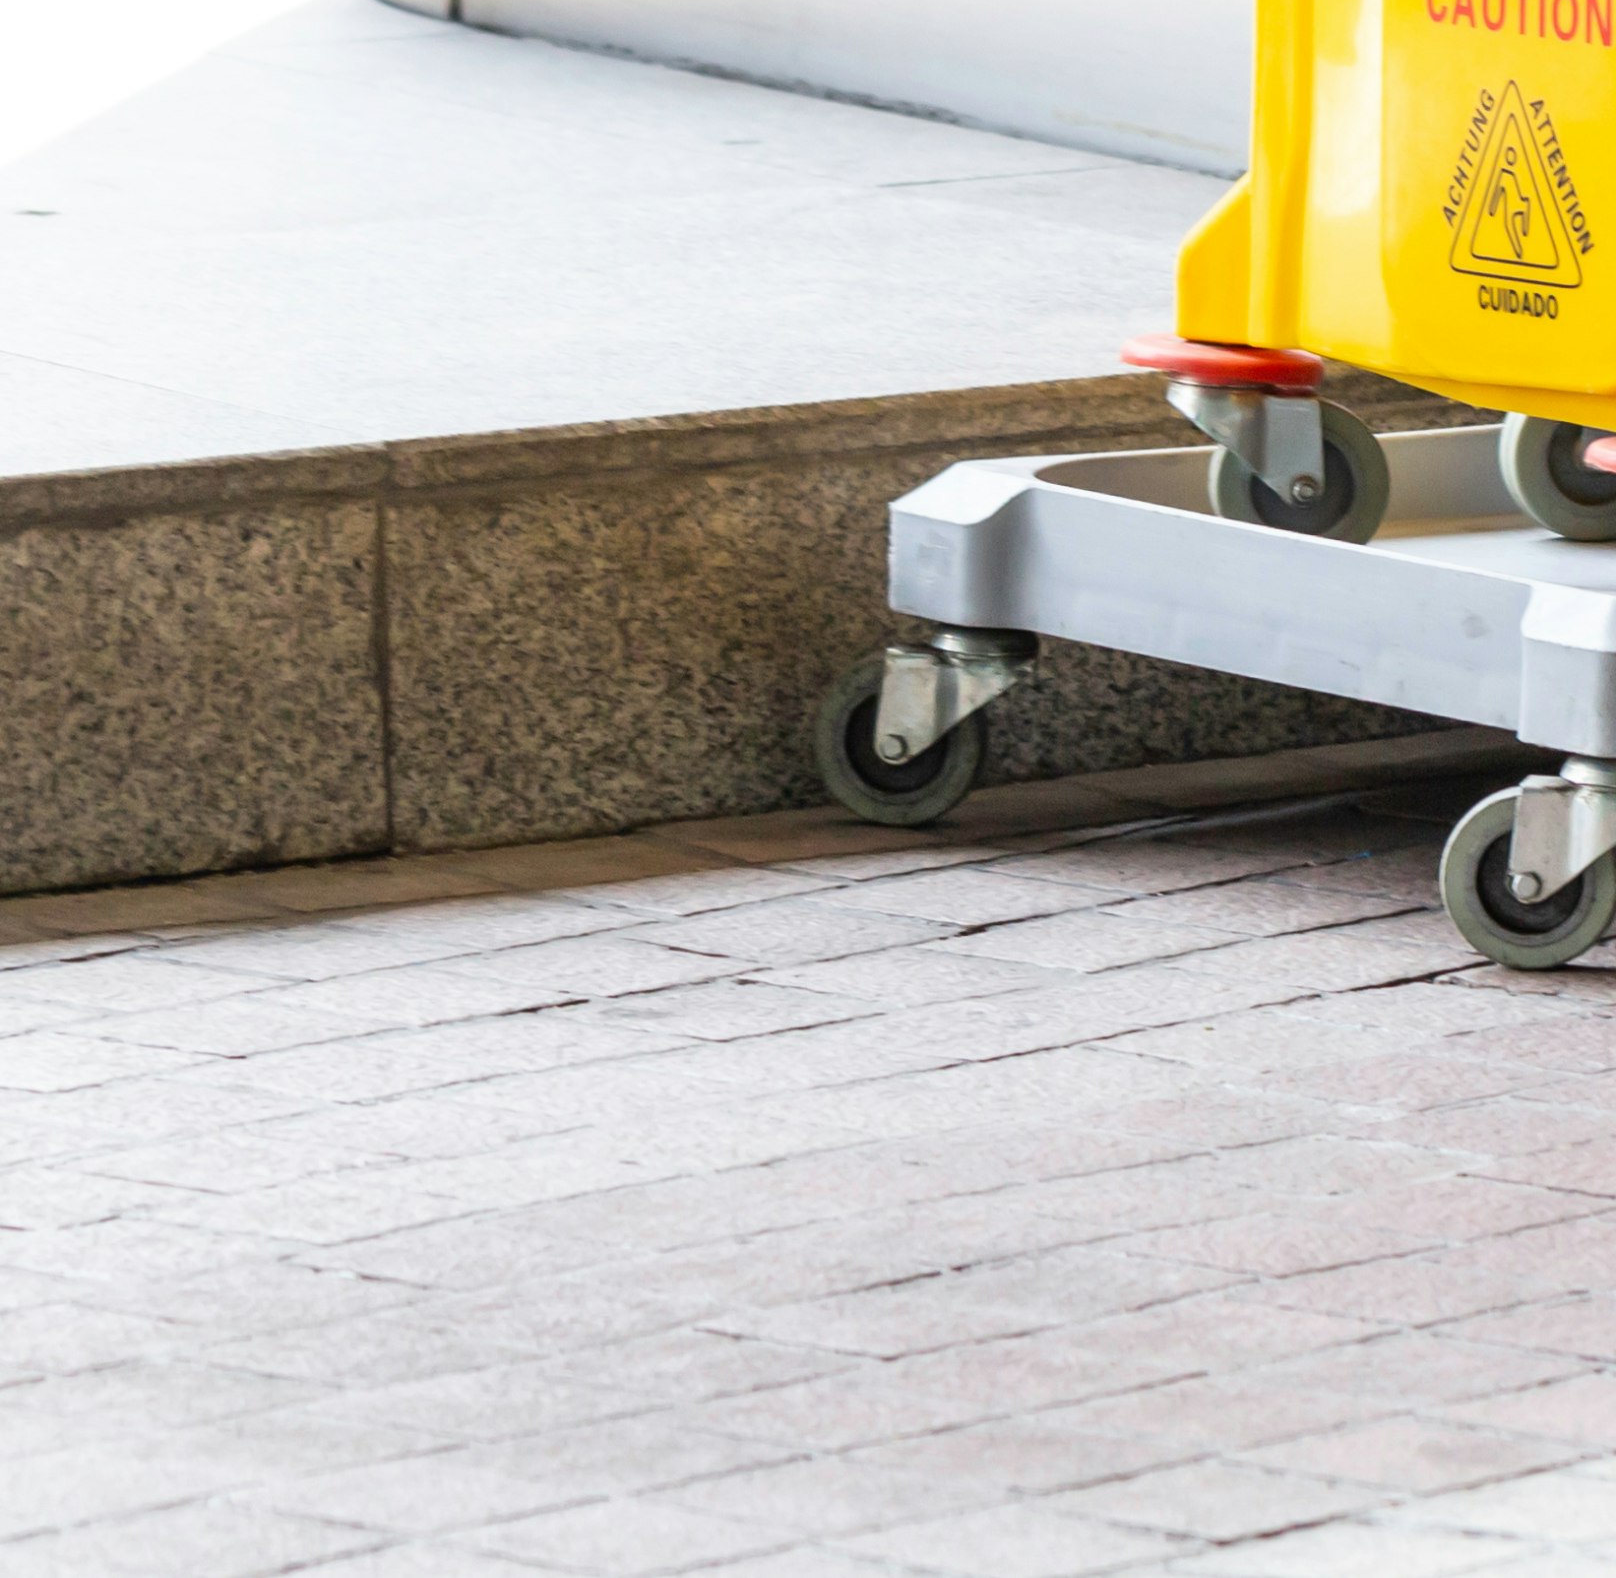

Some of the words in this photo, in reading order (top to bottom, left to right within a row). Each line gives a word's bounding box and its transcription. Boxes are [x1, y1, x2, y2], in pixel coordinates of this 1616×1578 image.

[1441, 88, 1496, 227] ACHTUNG
[1529, 99, 1595, 256] ATTENTION
[1478, 284, 1559, 320] CUIDADO
